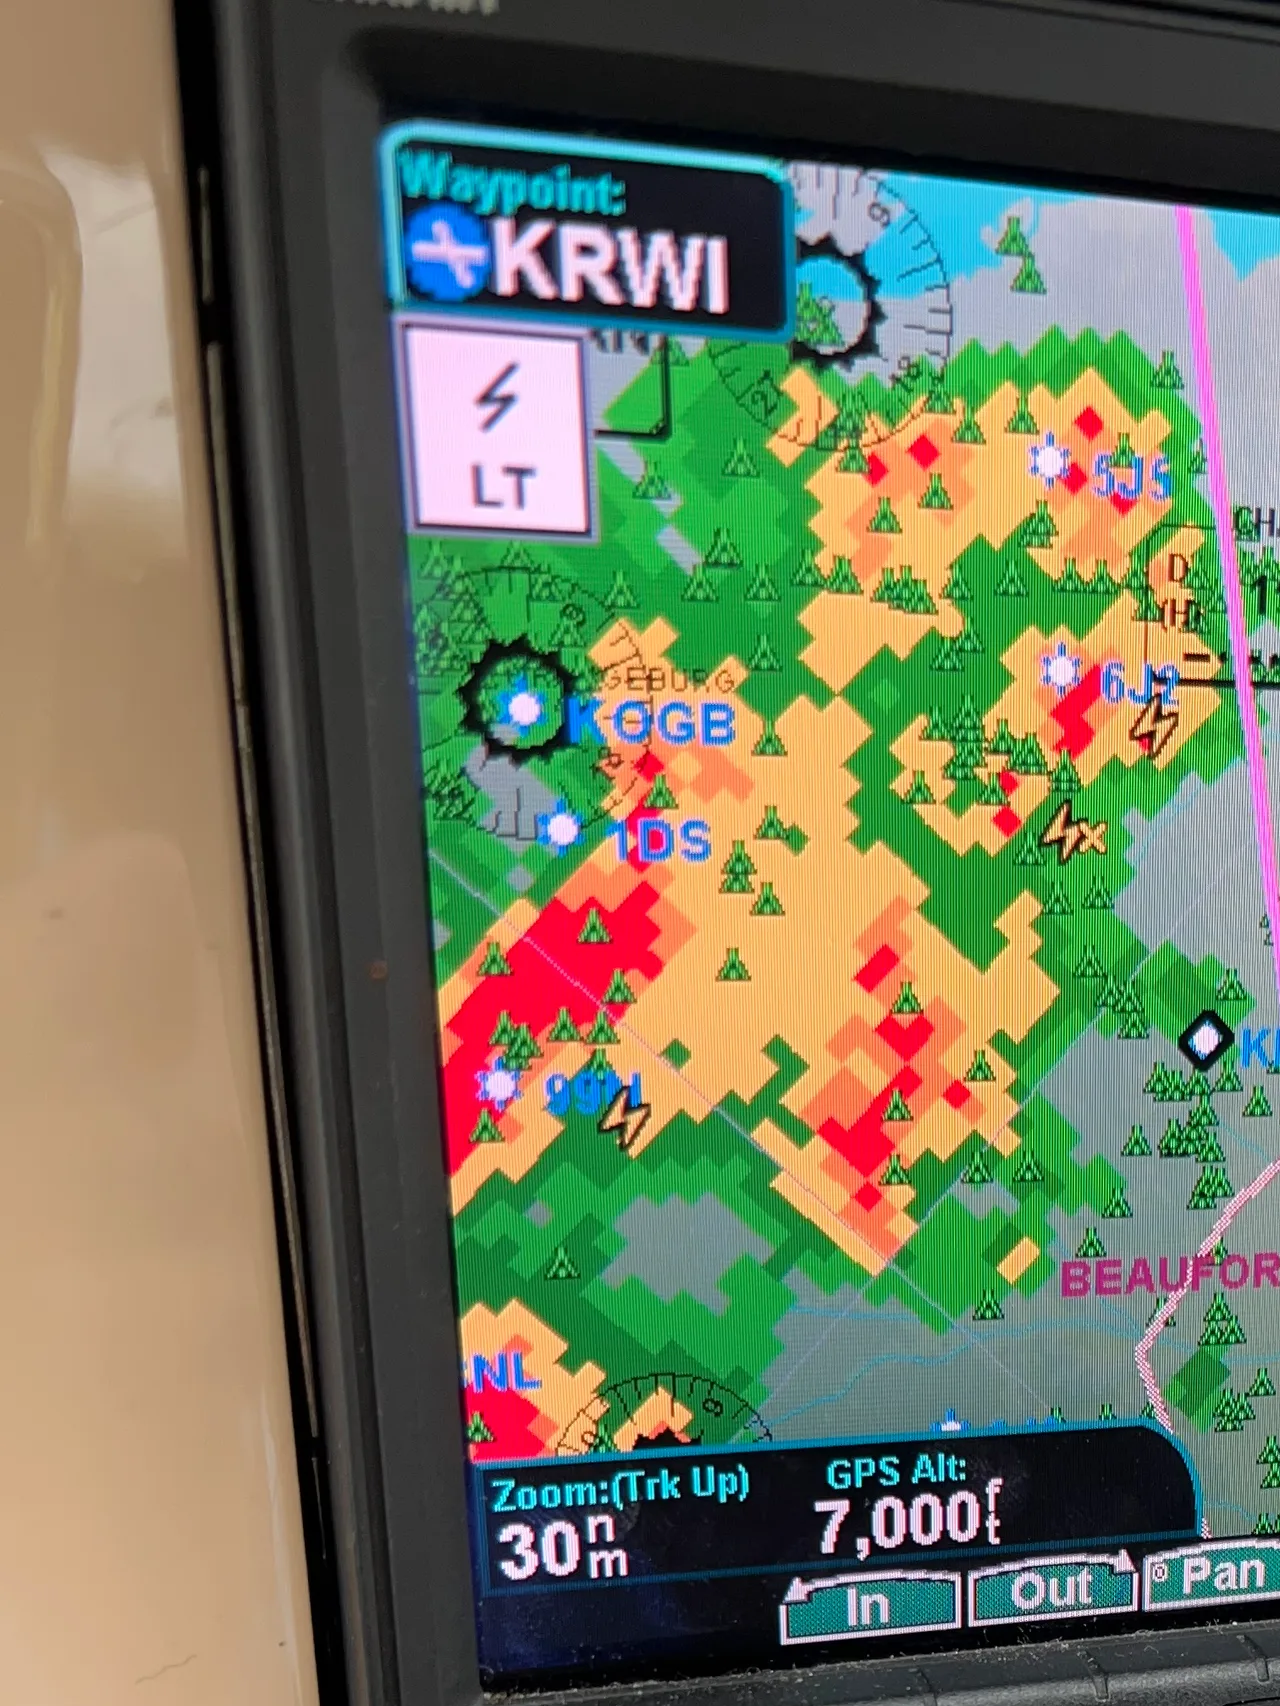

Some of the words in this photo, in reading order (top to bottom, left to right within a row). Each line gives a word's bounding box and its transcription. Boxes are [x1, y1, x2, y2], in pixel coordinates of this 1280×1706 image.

[400, 150, 626, 216] Waypoint:
[490, 216, 730, 314] KRWI
[471, 463, 537, 509] LT
[567, 697, 736, 748] KOGB
[461, 1350, 543, 1392] NL
[691, 1463, 750, 1502] Up)
[826, 1457, 900, 1491] GPS
[912, 1452, 967, 1484] Alt:
[814, 1491, 980, 1561] 7,000
[498, 1518, 581, 1582] 30
[1010, 1569, 1094, 1612] Out
[1182, 1554, 1266, 1596] Pan
[847, 1586, 890, 1627] In
